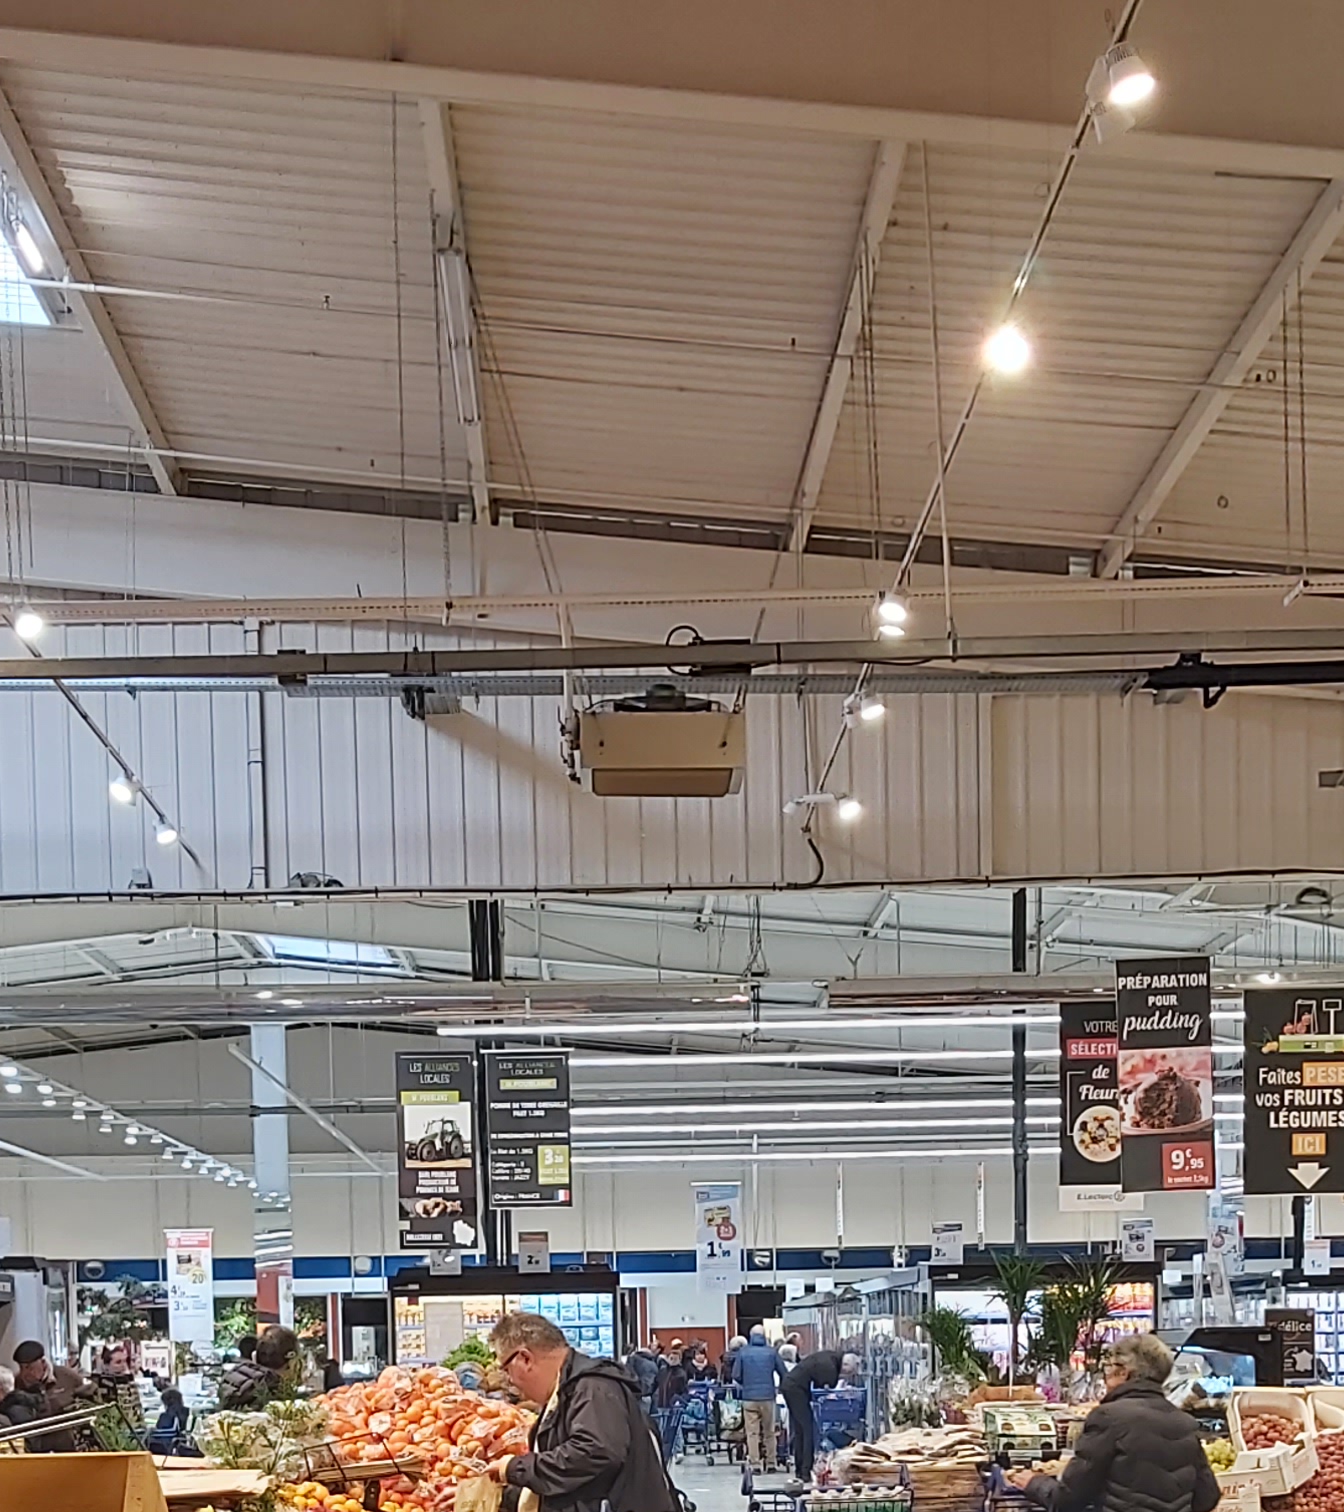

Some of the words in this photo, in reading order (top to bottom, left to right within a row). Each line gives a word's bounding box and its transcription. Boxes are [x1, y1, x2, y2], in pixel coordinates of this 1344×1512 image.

[1117, 971, 1208, 990] PRÉPARATION
[1147, 994, 1179, 1008] POUR
[1083, 1020, 1118, 1034] VOTRE
[1122, 1010, 1204, 1041] pudding
[1070, 1040, 1117, 1056] SÉLECTI
[1092, 1064, 1110, 1080] de
[1258, 1067, 1301, 1086] Faites
[1079, 1085, 1119, 1101] Fleur
[1256, 1093, 1280, 1107] vos
[1283, 1089, 1343, 1107] FRUITS
[1297, 1137, 1320, 1152] ICI
